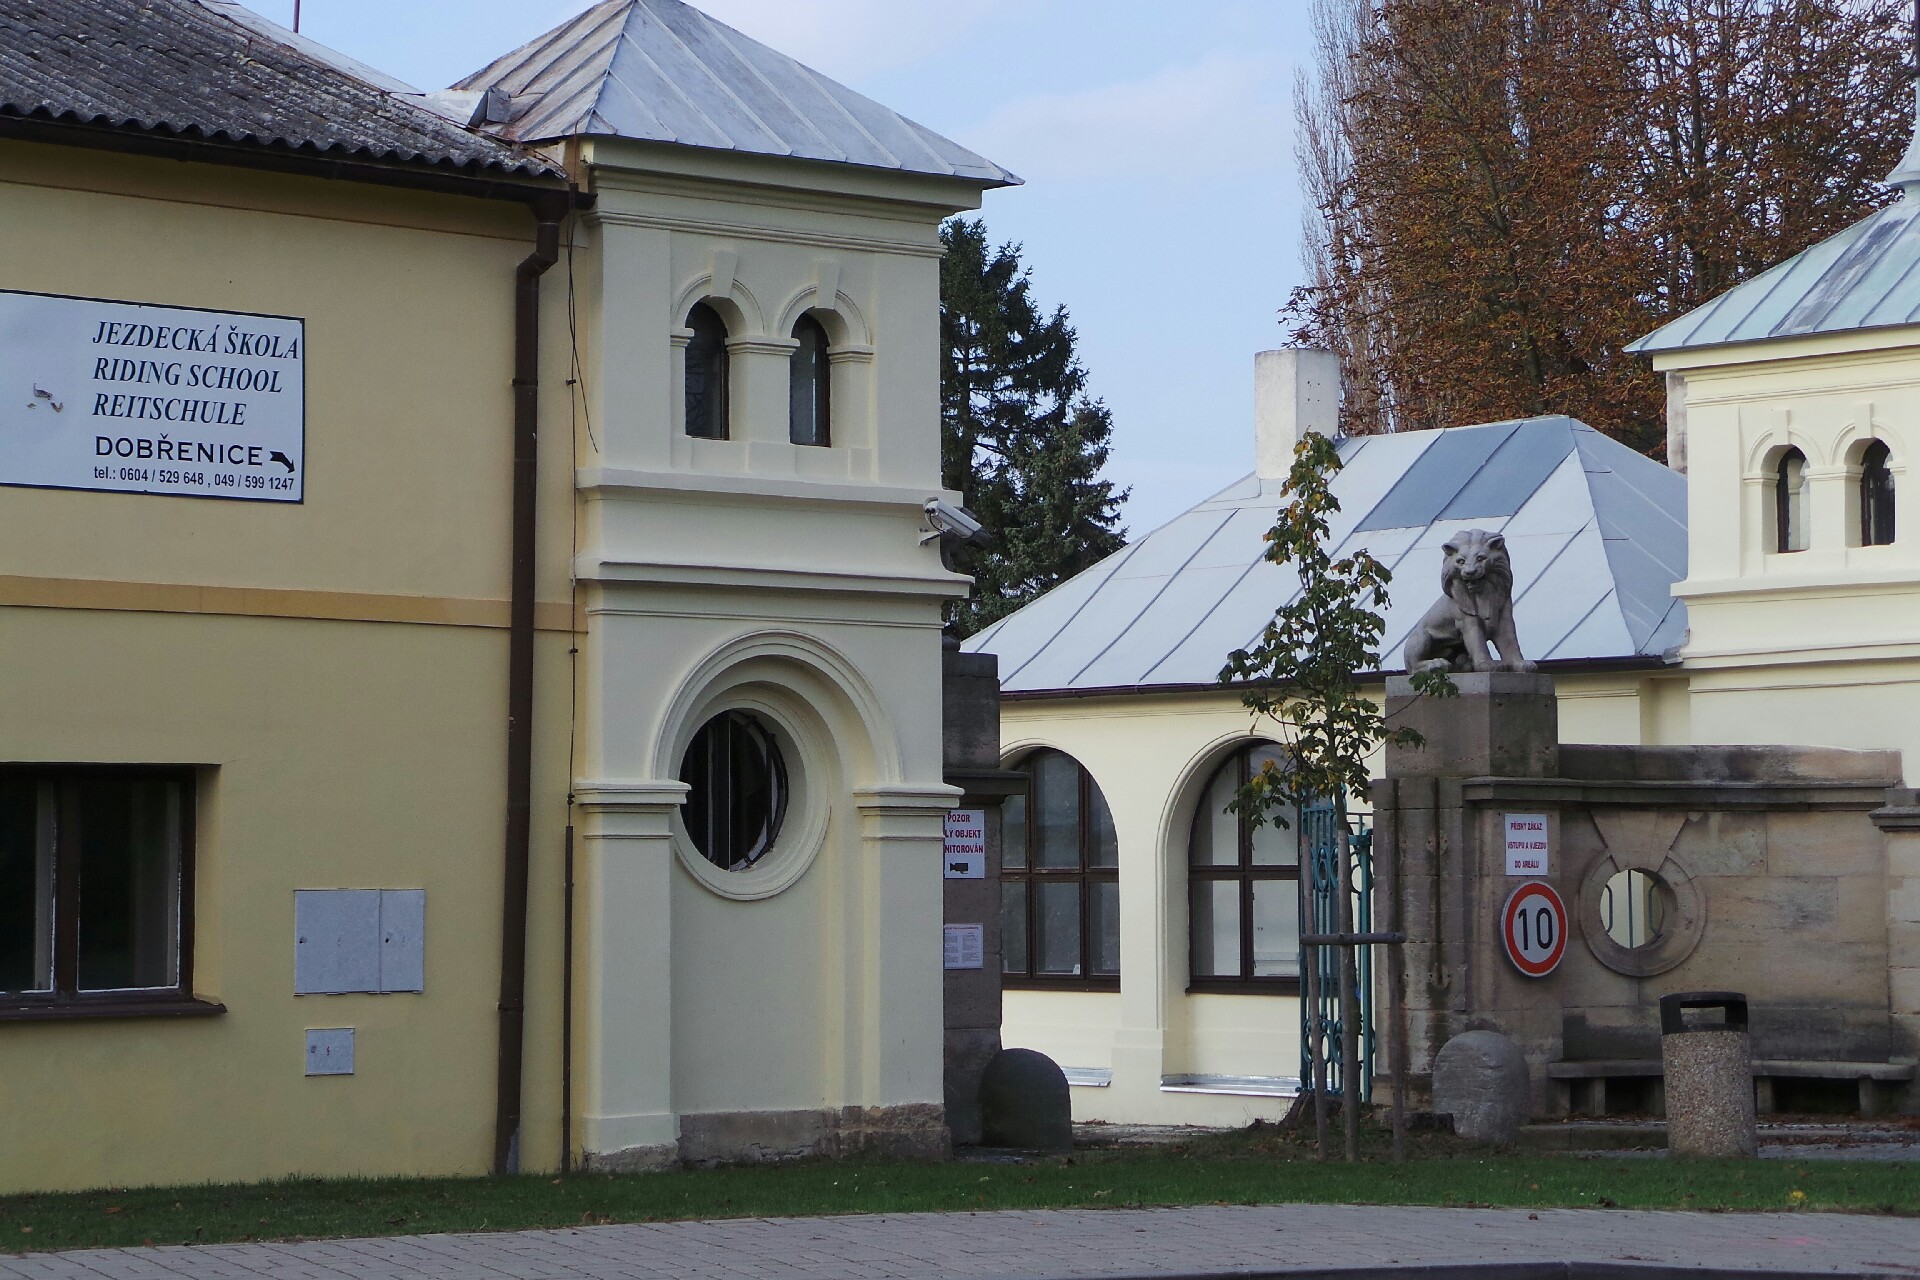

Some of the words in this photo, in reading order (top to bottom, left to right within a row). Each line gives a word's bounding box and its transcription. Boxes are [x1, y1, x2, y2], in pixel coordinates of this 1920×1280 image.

[92, 321, 219, 353] JEZDECKÁ
[224, 325, 299, 359] ŠKOLA
[92, 357, 181, 386] RIDING
[187, 364, 283, 393] SCHOOL
[92, 393, 247, 426] REITSCHULE
[95, 433, 263, 466] DOBŘENICE
[94, 466, 116, 480] tel.:
[119, 468, 149, 482] 0604
[159, 470, 180, 484] 529
[183, 471, 204, 485] 648
[214, 473, 235, 487] 049
[244, 475, 265, 489] 599
[268, 477, 295, 491] 1247
[948, 814, 970, 822] POZOR
[955, 829, 981, 838] OBJEKT
[1518, 907, 1553, 951] 10
